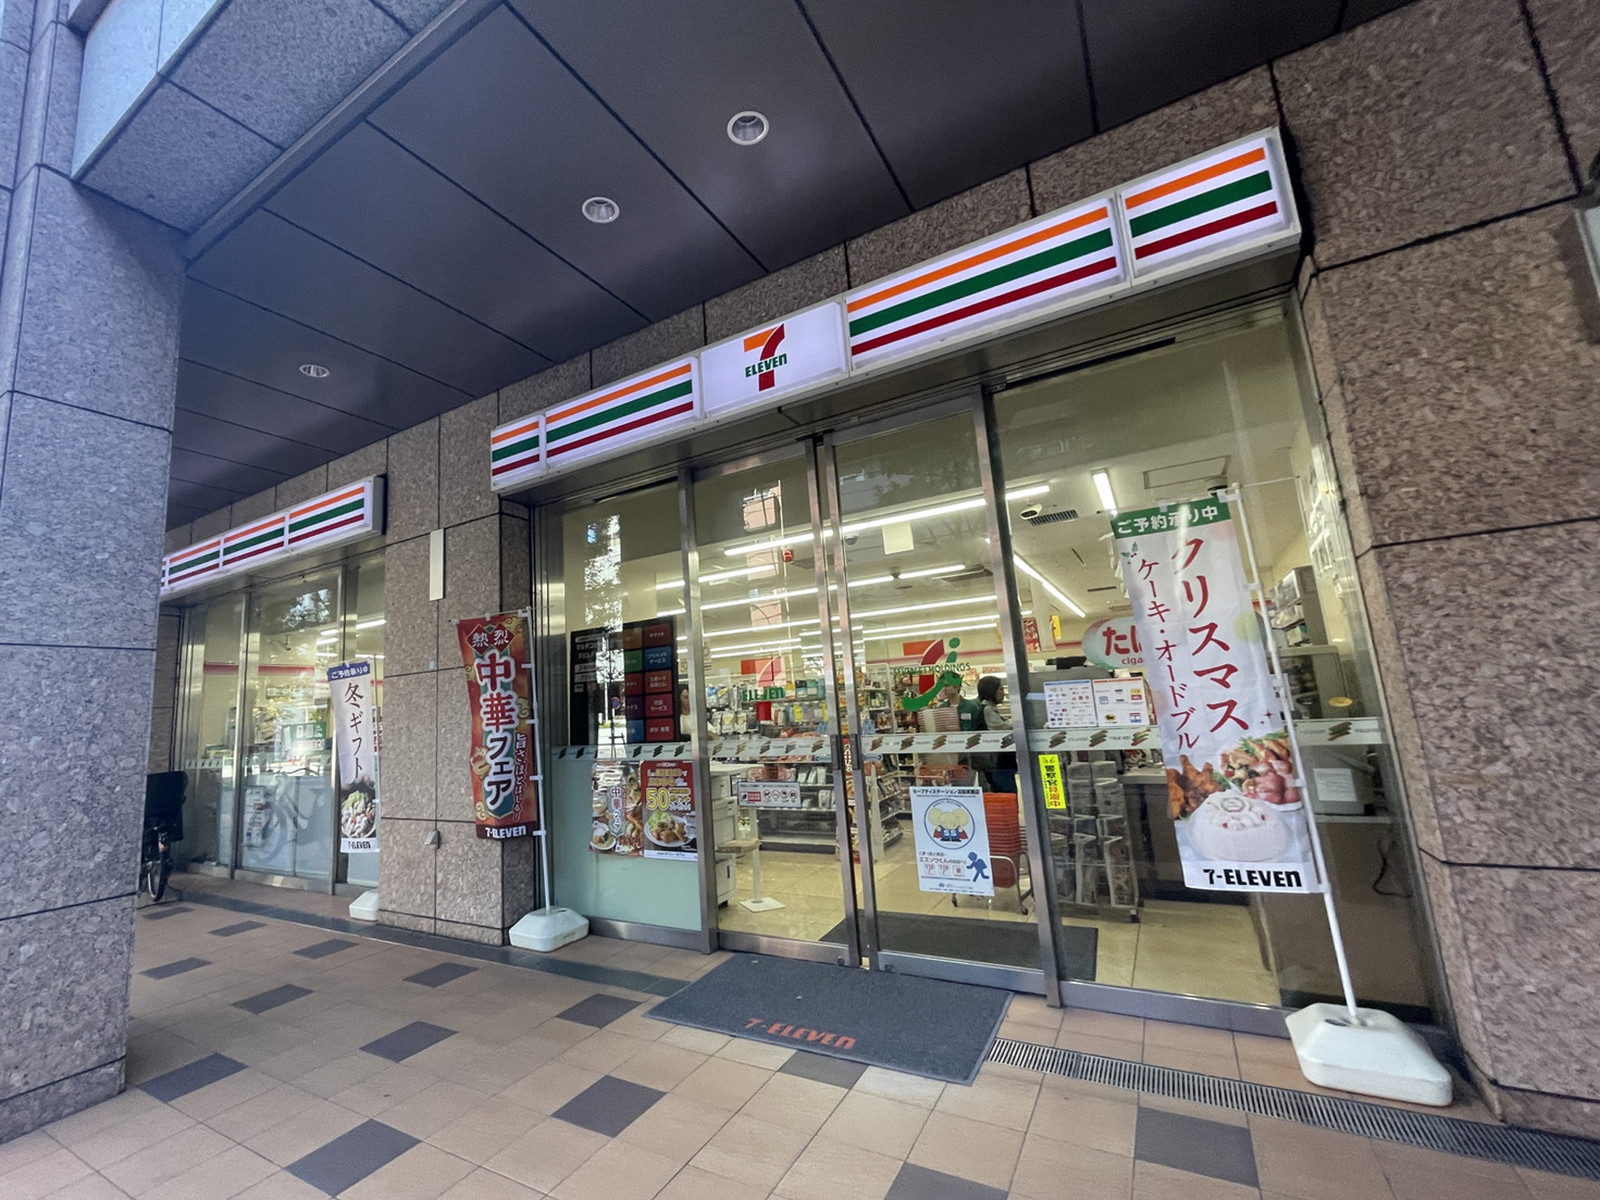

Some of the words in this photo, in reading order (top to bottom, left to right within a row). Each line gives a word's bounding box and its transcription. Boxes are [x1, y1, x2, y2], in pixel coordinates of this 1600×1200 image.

[472, 629, 510, 648] 熱烈
[1137, 558, 1201, 751] ケーキ・オードブル
[1171, 537, 1249, 733] クリスマス
[345, 682, 364, 779] 冬ギフト
[477, 654, 516, 806] 中華フェア
[646, 787, 669, 811] 50
